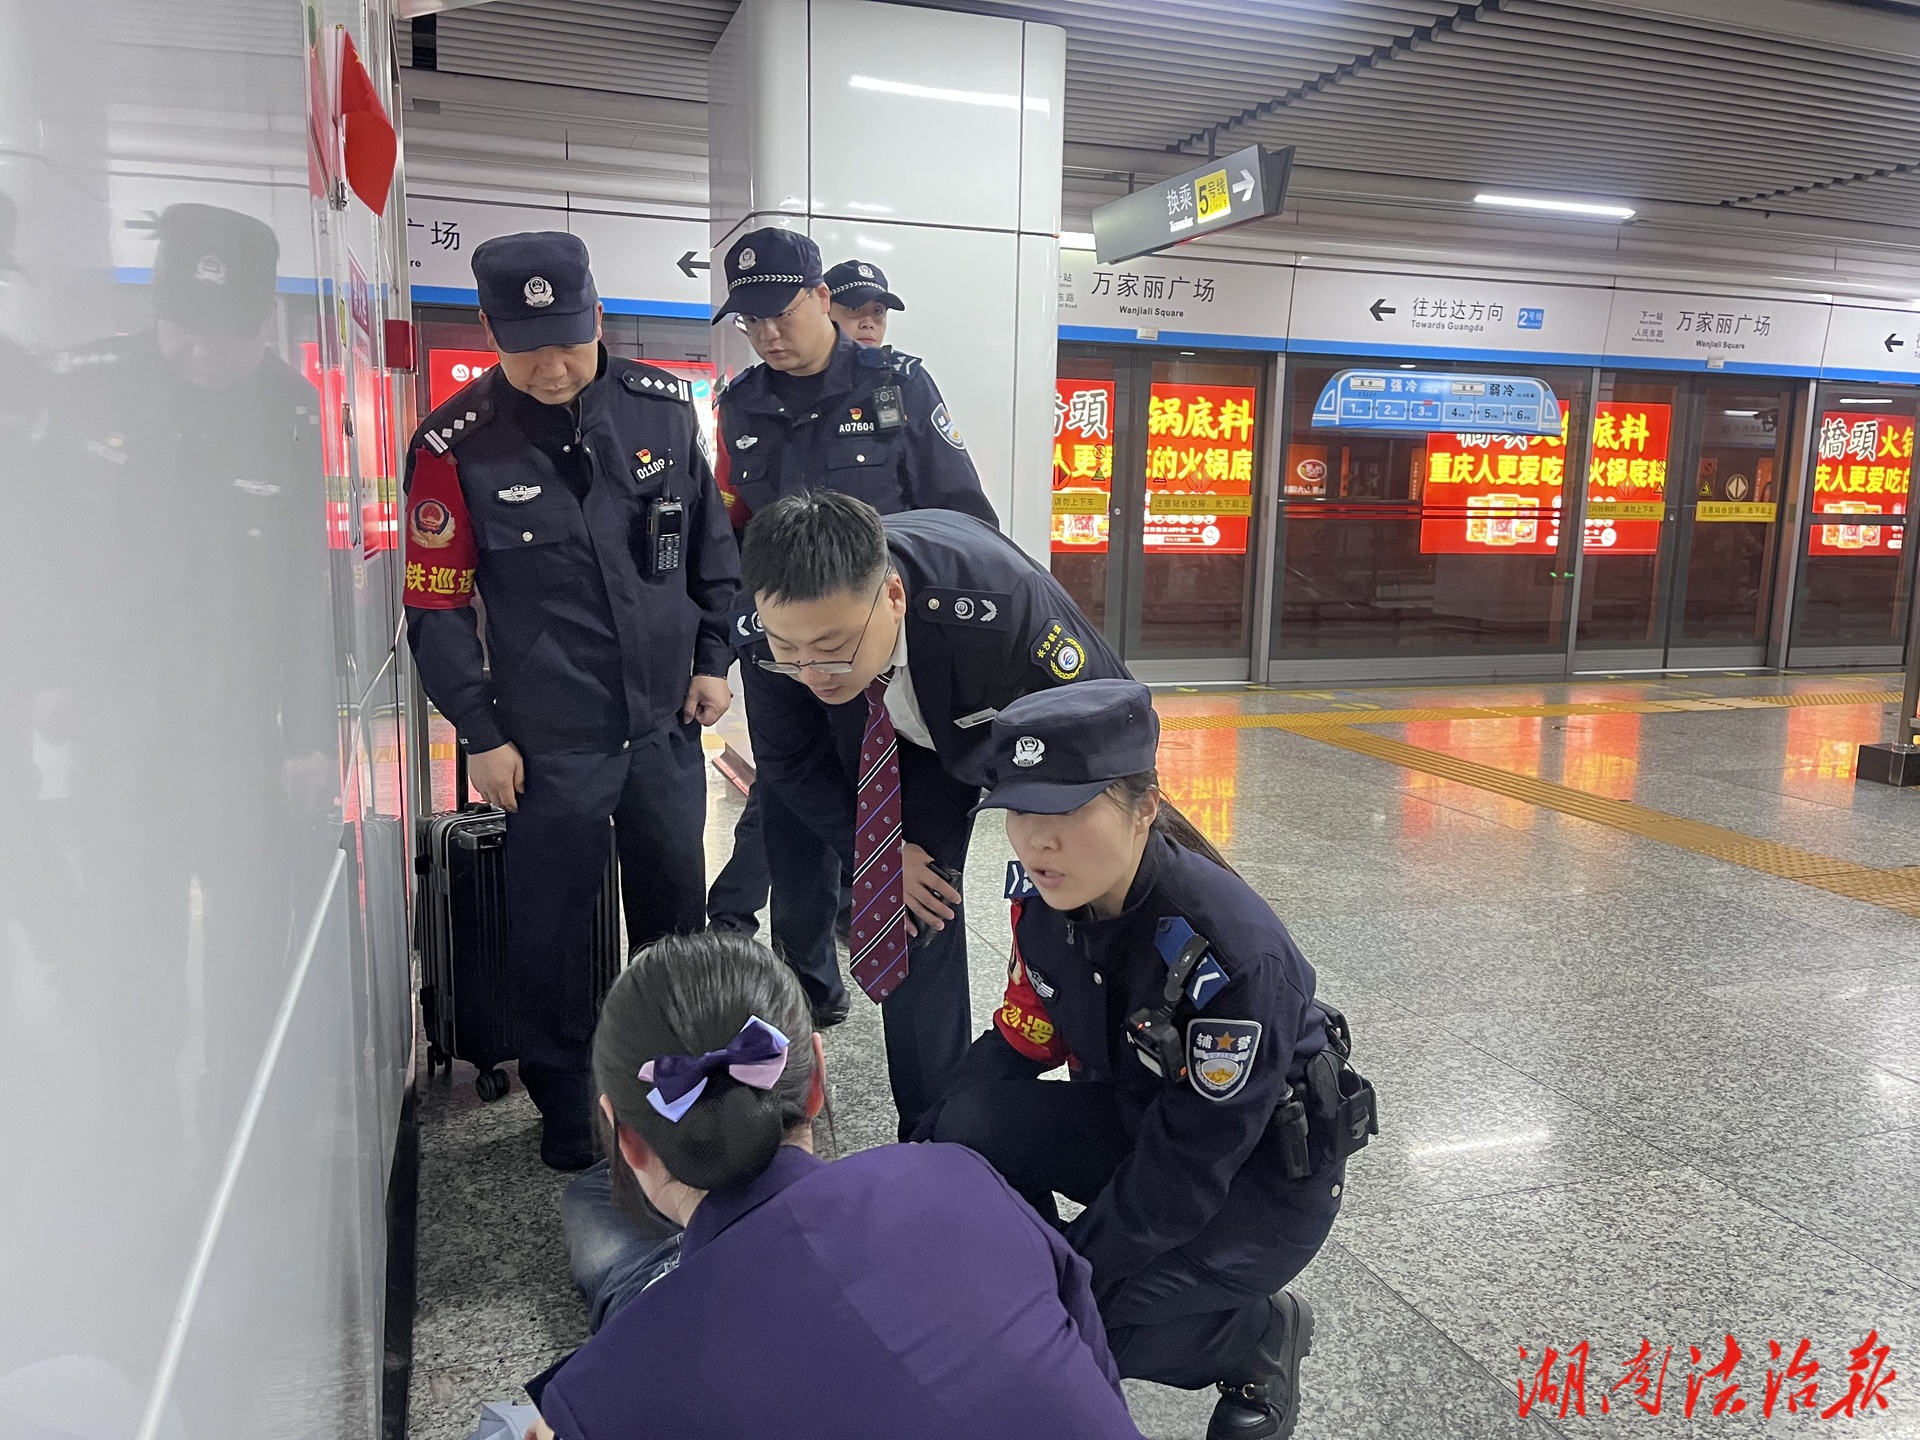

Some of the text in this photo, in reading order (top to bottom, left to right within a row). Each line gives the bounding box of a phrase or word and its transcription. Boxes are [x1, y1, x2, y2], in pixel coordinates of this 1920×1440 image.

[1166, 183, 1193, 215] 换乘
[1091, 271, 1215, 302] 万家丽广场
[1154, 307, 1184, 318] Square
[1412, 297, 1504, 322] 往光达方向
[1411, 320, 1484, 333] Towards Guangda
[1676, 311, 1771, 337] 万家丽广场
[1723, 341, 1746, 351] Square
[1489, 384, 1515, 397] 弱冷
[839, 422, 875, 433] A07604
[1148, 396, 1254, 443] 锅底料
[1592, 412, 1650, 452] 底料
[1146, 445, 1253, 482] 的火锅底
[1429, 452, 1563, 487] 重庆人更爱吃
[1589, 457, 1668, 489] 火锅底料
